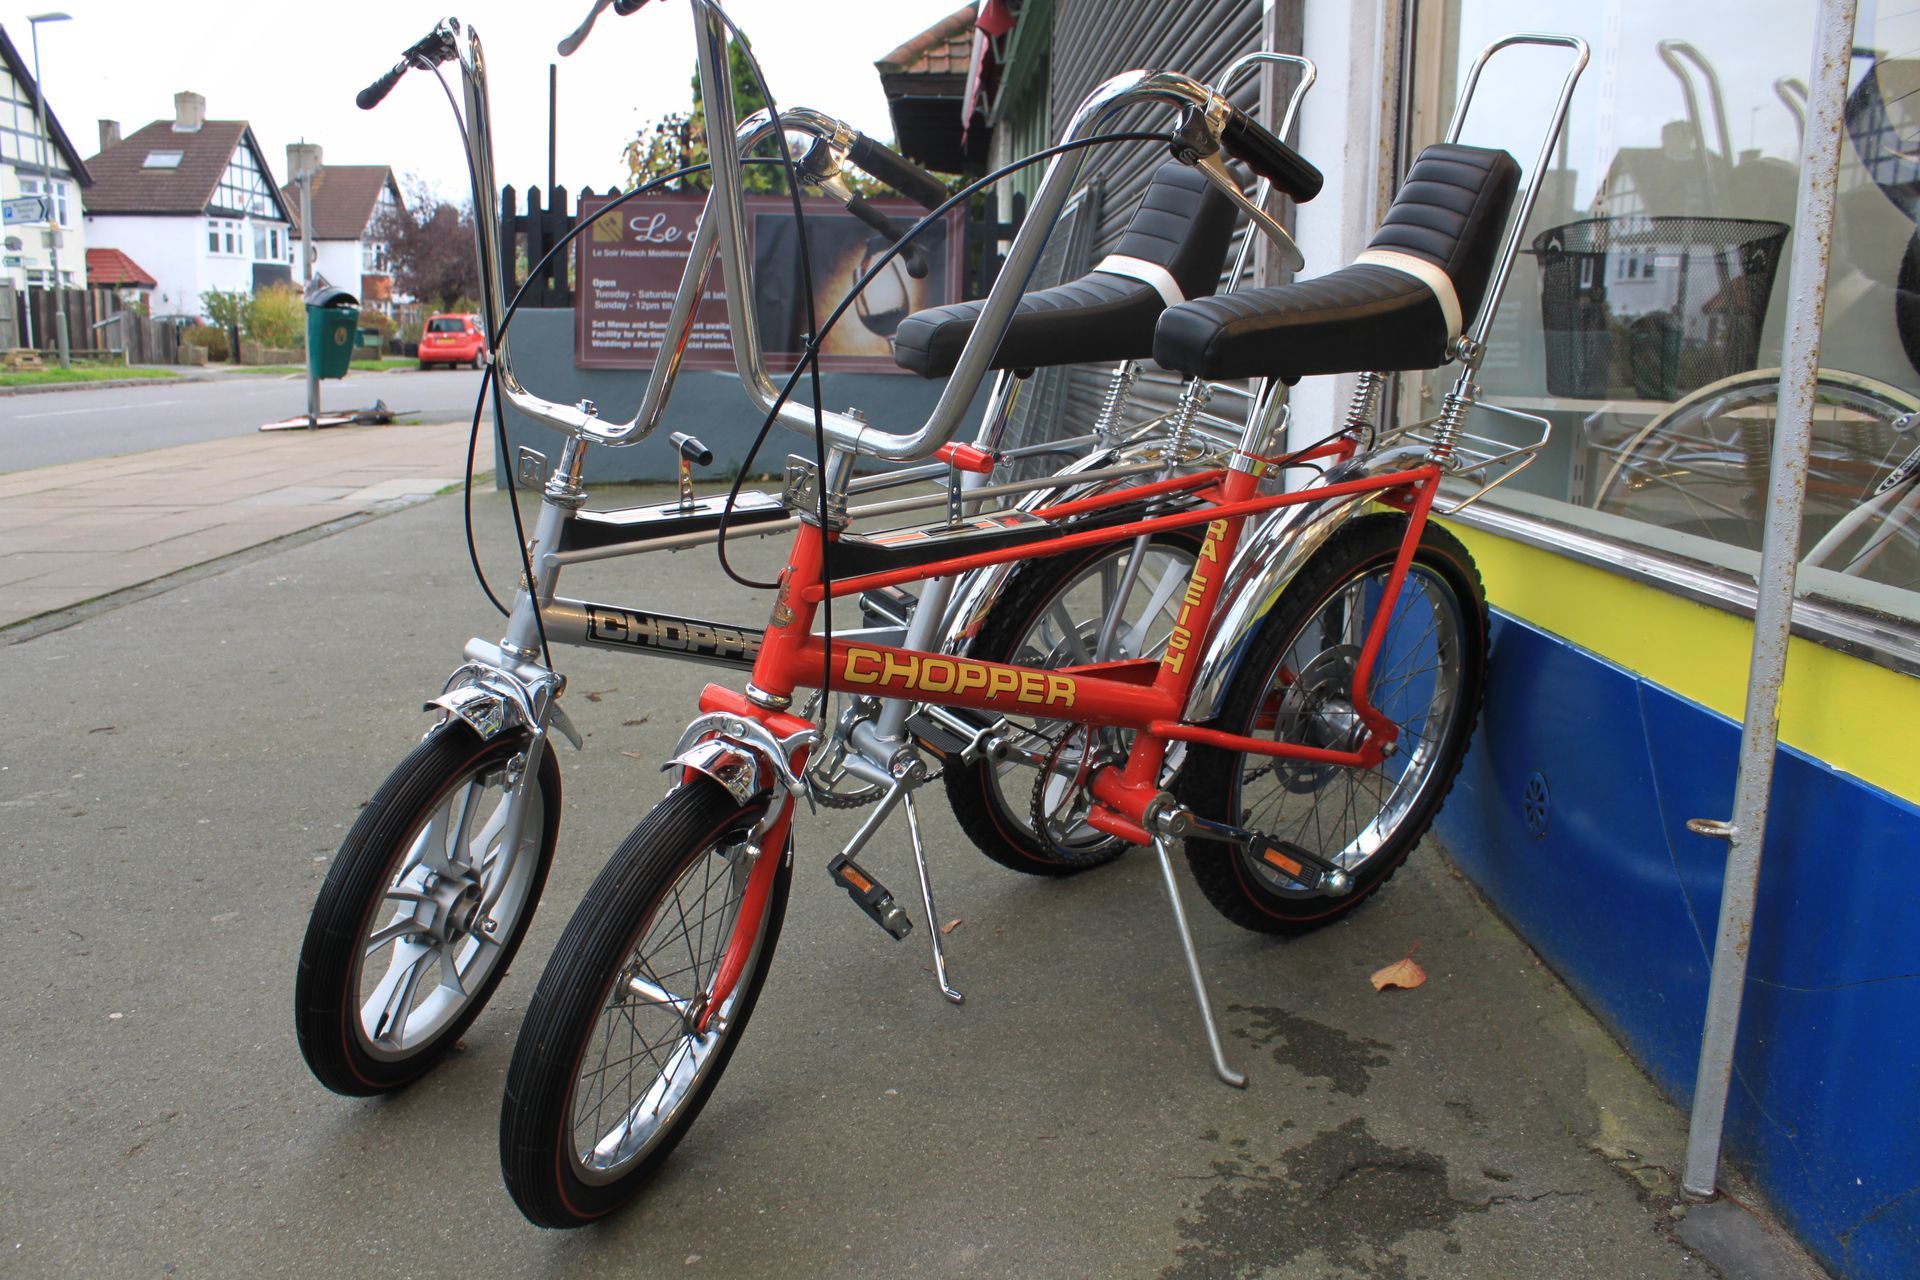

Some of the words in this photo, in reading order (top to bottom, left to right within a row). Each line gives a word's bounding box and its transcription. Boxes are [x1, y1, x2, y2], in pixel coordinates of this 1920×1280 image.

[629, 212, 682, 243] Le
[592, 249, 601, 257] Le
[603, 249, 618, 257] Soir
[620, 249, 646, 257] French
[592, 278, 617, 288] Open
[595, 290, 630, 299] Tuesday
[594, 301, 627, 311] Sunday
[636, 302, 660, 311] 12pm
[592, 330, 621, 339] Facility
[592, 340, 631, 349] Weddings
[1160, 518, 1229, 674] RALEIGH
[594, 609, 763, 658] CHOPPE
[843, 647, 1076, 708] CHOPPER
